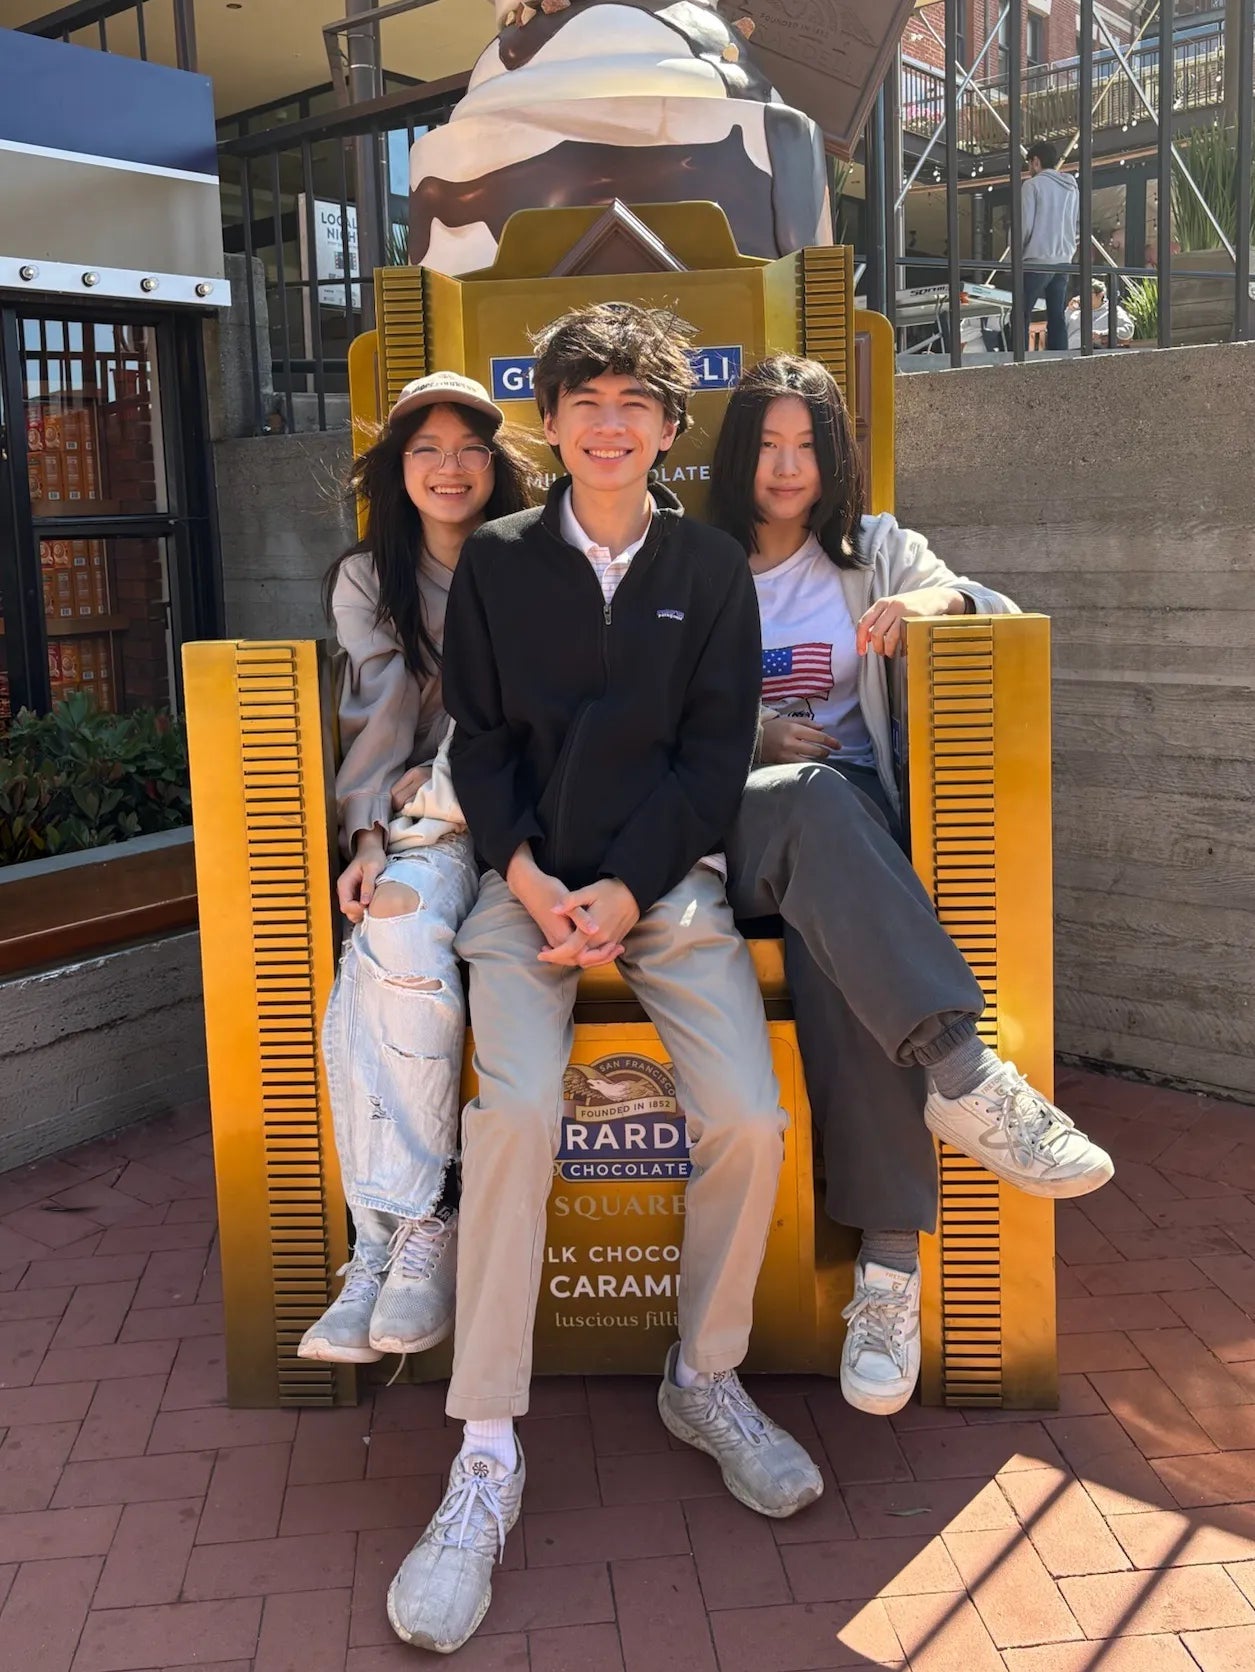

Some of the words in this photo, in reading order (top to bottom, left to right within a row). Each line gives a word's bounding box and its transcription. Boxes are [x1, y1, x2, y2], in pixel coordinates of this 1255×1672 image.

[327, 227, 356, 243] NIH
[600, 1060, 621, 1072] SAN
[625, 1060, 675, 1096] FRANCISCO
[581, 1105, 630, 1118] FOUNDED
[633, 1102, 645, 1111] IN
[649, 1100, 671, 1109] 1852
[570, 1163, 688, 1176] CHOCOLATE
[555, 1312, 639, 1327] luscious
